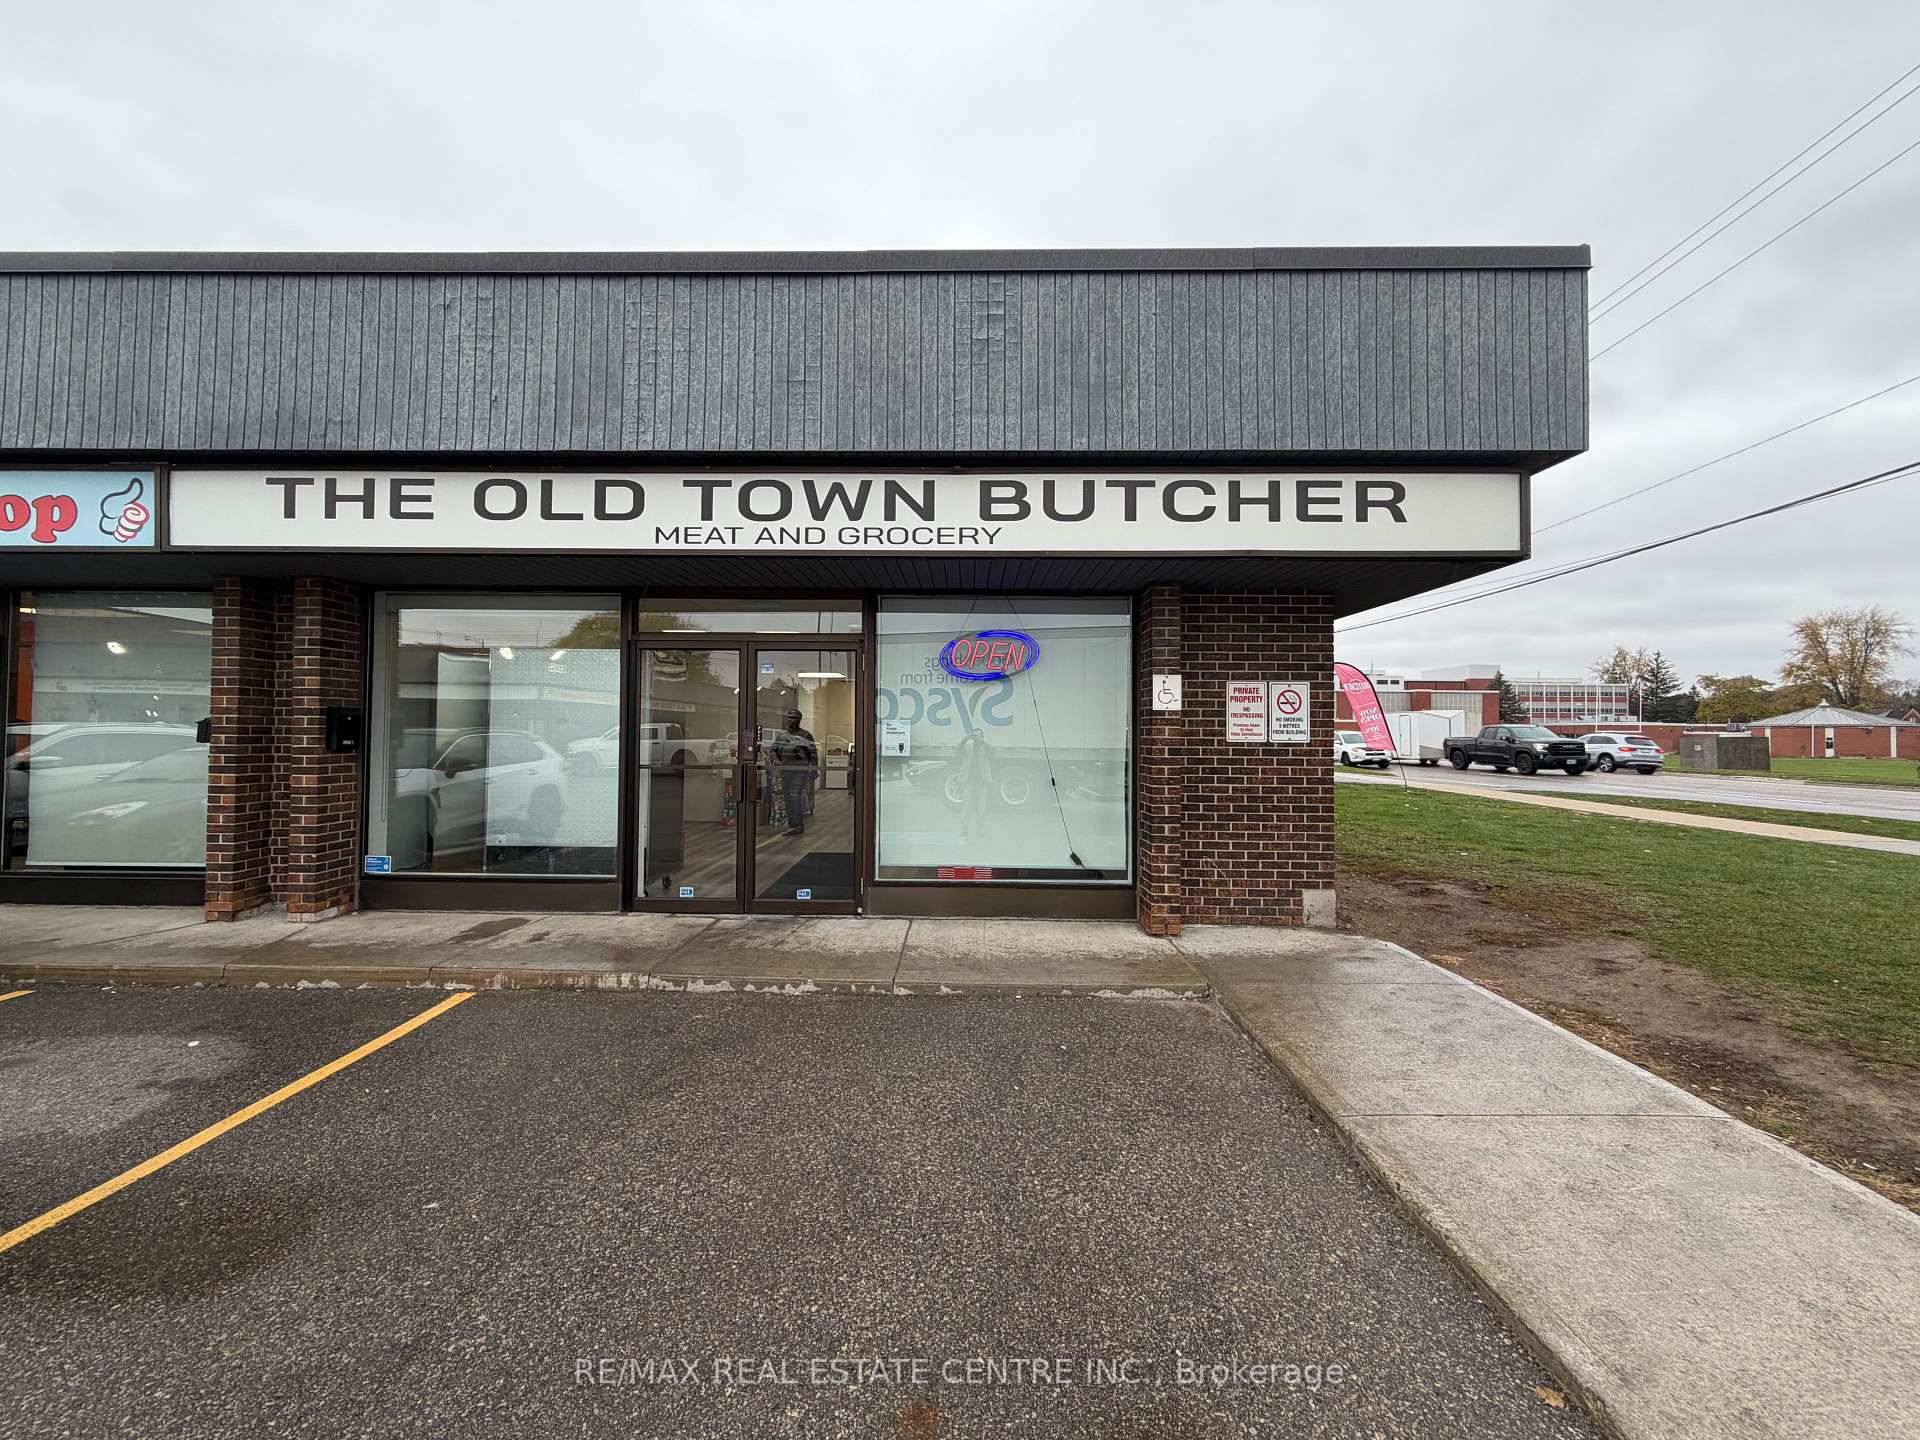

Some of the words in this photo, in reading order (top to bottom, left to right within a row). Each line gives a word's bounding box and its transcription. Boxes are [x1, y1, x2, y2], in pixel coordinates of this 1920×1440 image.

[265, 477, 436, 520] THE
[473, 478, 646, 522] OLD
[682, 479, 936, 522] TOWN
[978, 479, 1408, 523] BUTCHER
[655, 526, 744, 545] MEAT
[754, 526, 827, 545] AND
[837, 526, 1003, 546] GROCERY
[952, 639, 1025, 672] OPEN
[1233, 687, 1260, 695] PRIVATE
